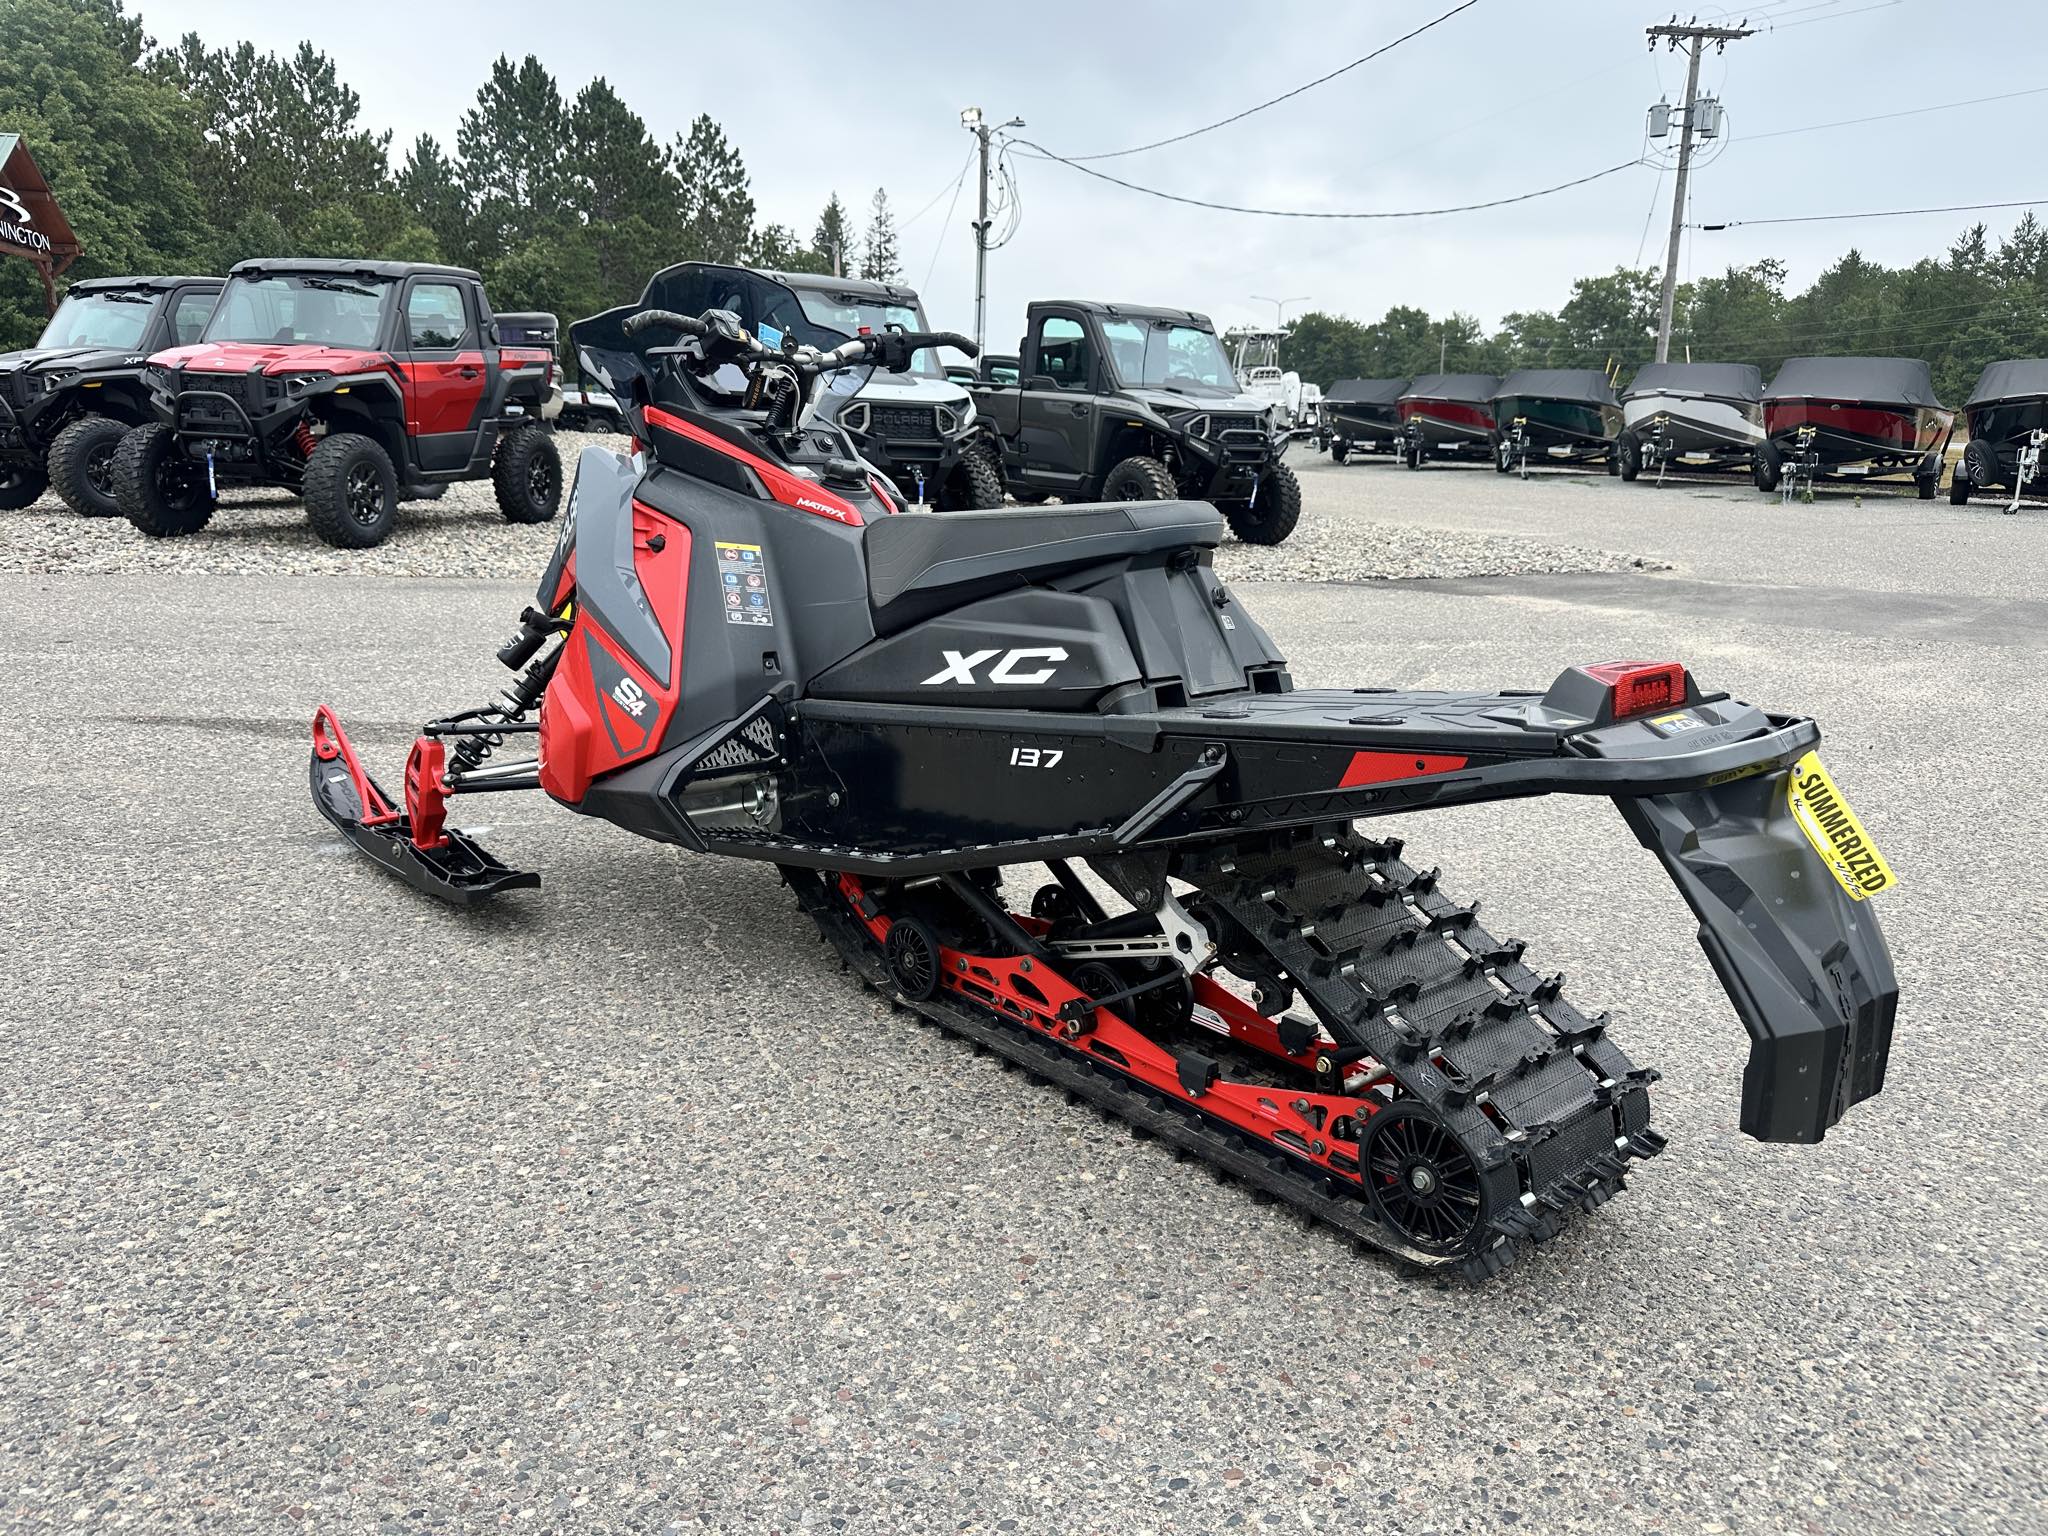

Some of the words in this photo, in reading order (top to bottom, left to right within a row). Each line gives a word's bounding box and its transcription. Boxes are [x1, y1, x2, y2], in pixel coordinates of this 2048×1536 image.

[123, 357, 144, 365] XP
[872, 413, 933, 425] POLARIS
[796, 497, 848, 521] MATRYX
[920, 647, 1070, 685] XC
[614, 677, 648, 717] S4
[1009, 747, 1064, 769] 137
[1798, 773, 1887, 892] SUMMERIZED
